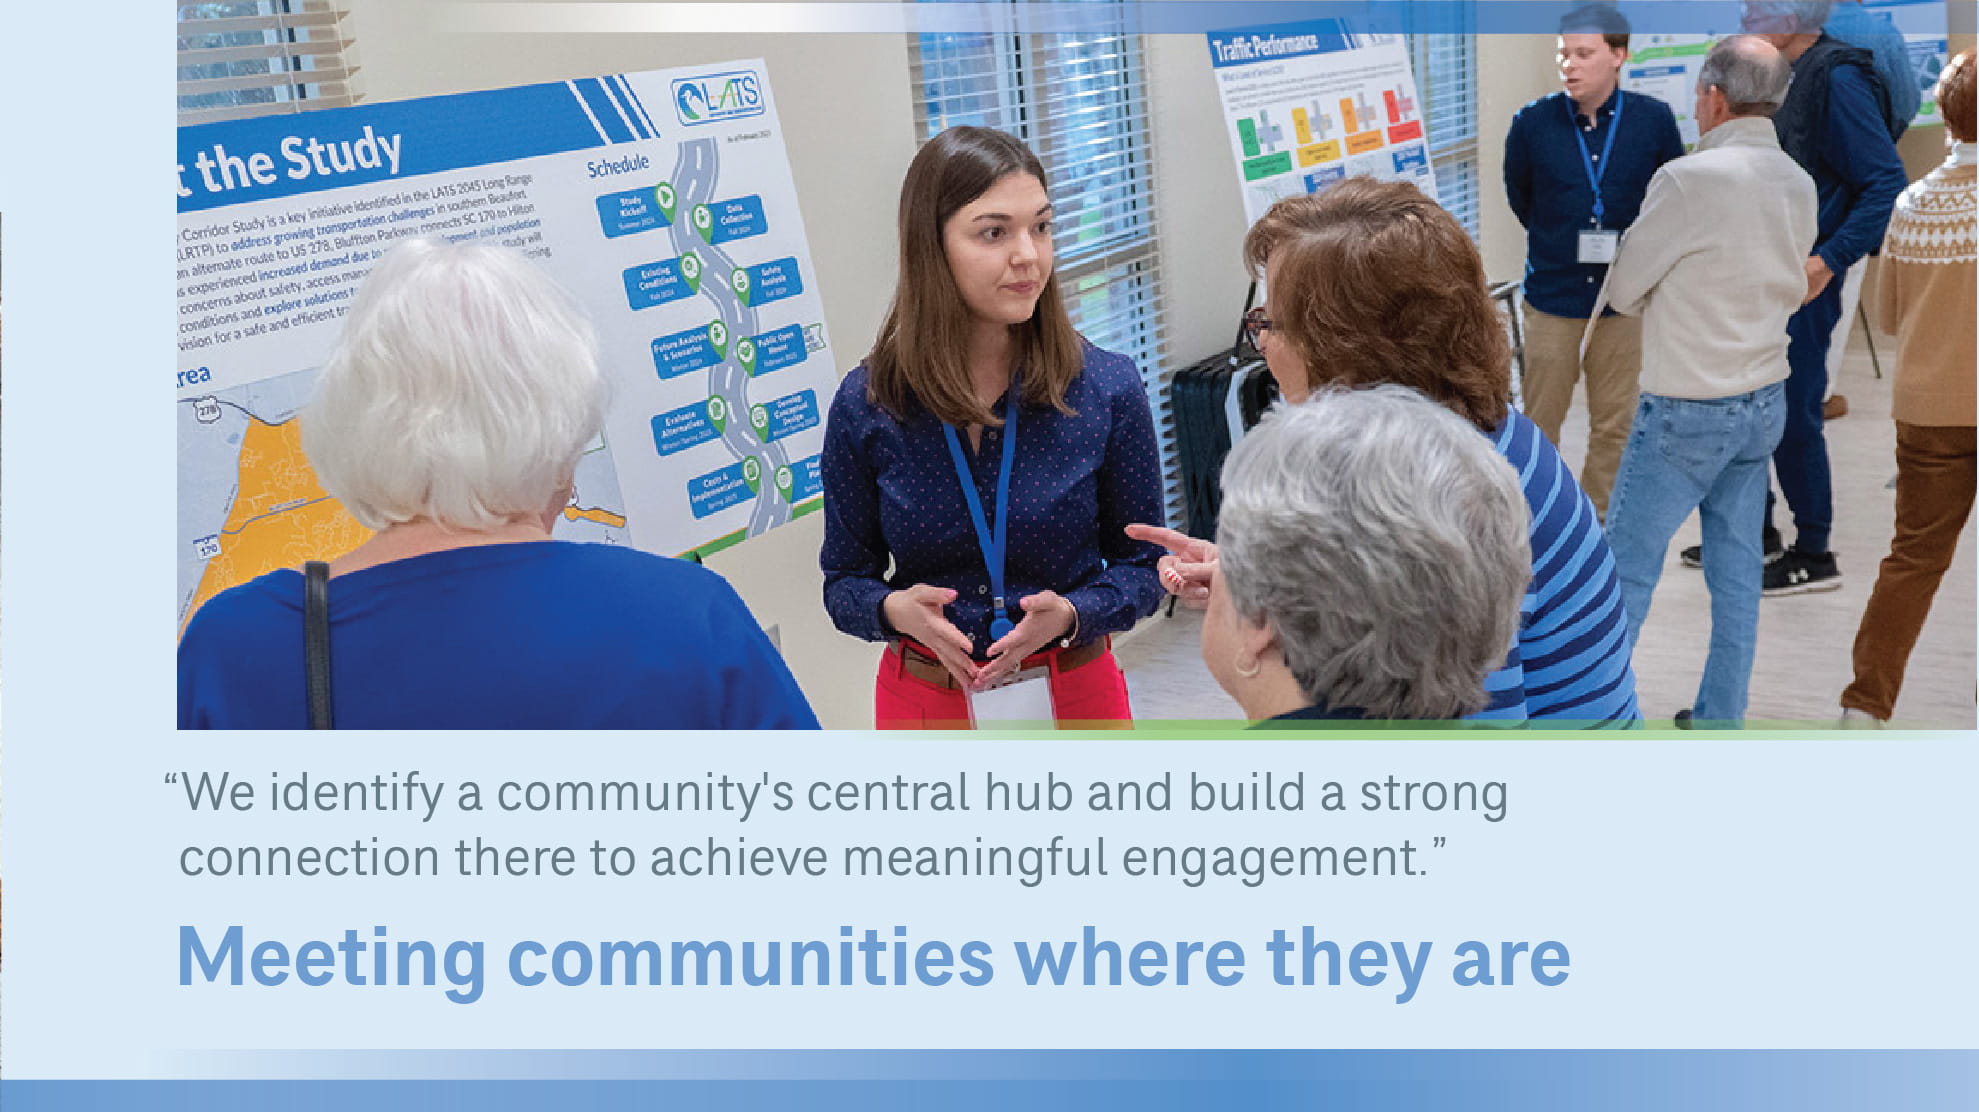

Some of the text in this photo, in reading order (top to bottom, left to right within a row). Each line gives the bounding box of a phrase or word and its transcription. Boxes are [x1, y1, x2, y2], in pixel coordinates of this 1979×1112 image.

[1212, 36, 1253, 62] Traffic
[701, 75, 758, 110] LATS
[195, 144, 277, 192] the
[281, 125, 401, 179] Study
[587, 153, 649, 178] Schedule
[181, 224, 230, 242] Corridor
[233, 217, 264, 233] Study
[266, 215, 277, 227] is
[279, 215, 286, 225] a
[287, 212, 306, 223] key
[430, 184, 456, 199] LATS
[216, 243, 228, 254] to
[230, 236, 272, 251] address
[274, 227, 315, 246] growing
[317, 214, 385, 235] transportation
[388, 207, 434, 222] challenges
[188, 271, 257, 295] experienced
[258, 261, 308, 281] increased
[310, 252, 349, 271] demand
[352, 250, 369, 264] due
[192, 258, 242, 277] alternate
[245, 252, 274, 265] route
[276, 249, 289, 260] to
[290, 243, 306, 258] US
[180, 297, 232, 315] concerns
[234, 288, 267, 305] about
[306, 274, 341, 289] access
[178, 335, 212, 351] vision
[214, 330, 231, 343] for
[234, 330, 241, 340] a
[243, 323, 267, 337] safe
[269, 316, 289, 331] and
[180, 312, 240, 334] conditions
[241, 306, 262, 320] and
[264, 299, 301, 315] explore
[177, 366, 211, 388] rea
